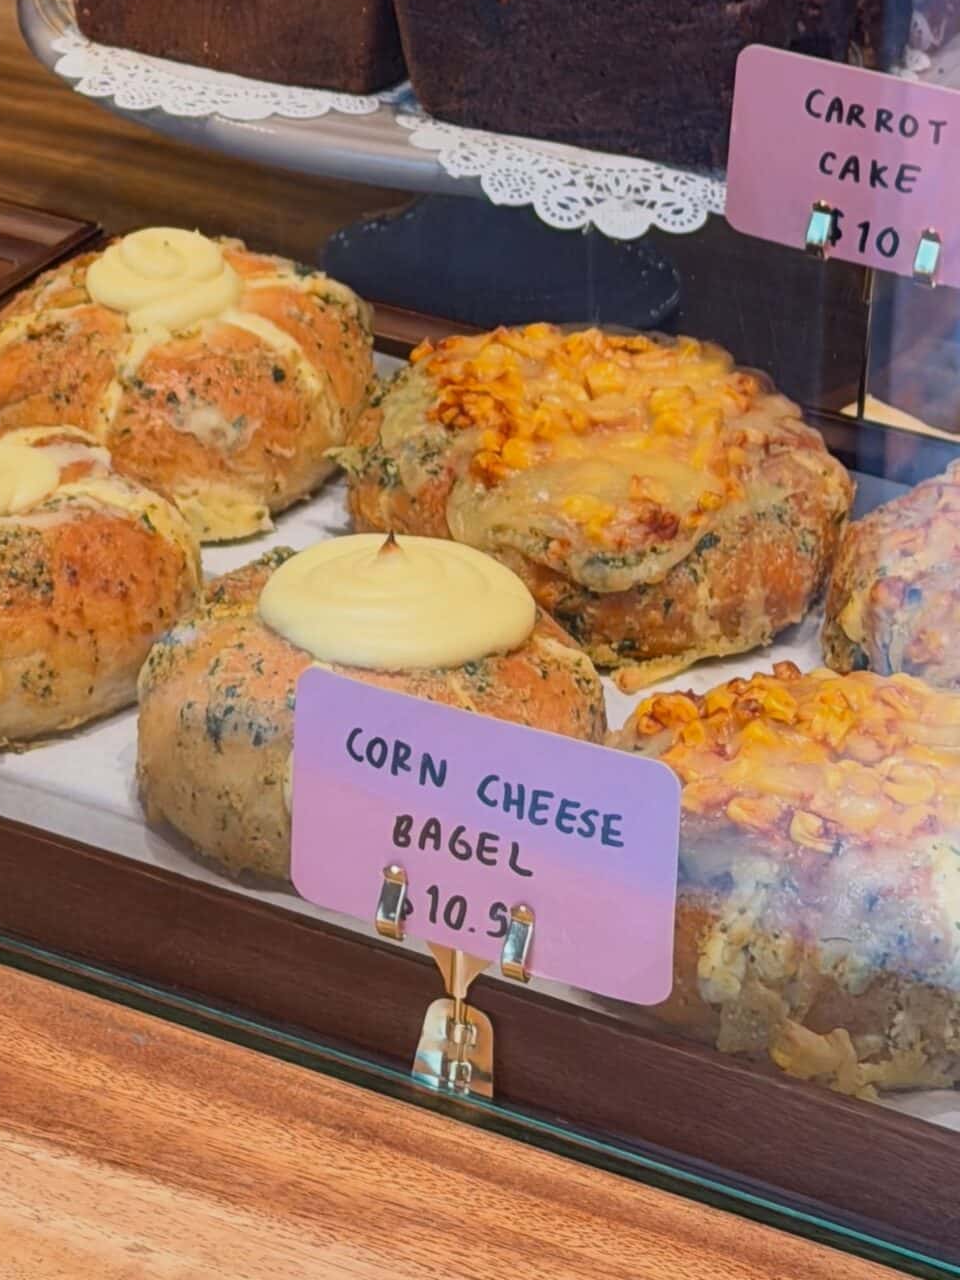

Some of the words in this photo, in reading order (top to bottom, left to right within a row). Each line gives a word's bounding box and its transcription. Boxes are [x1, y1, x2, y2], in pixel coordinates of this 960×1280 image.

[805, 89, 948, 145] CARROT
[818, 151, 922, 194] CAKE
[346, 727, 447, 788] CORN
[476, 774, 625, 848] CHEESE
[392, 814, 534, 877] BAGEL
